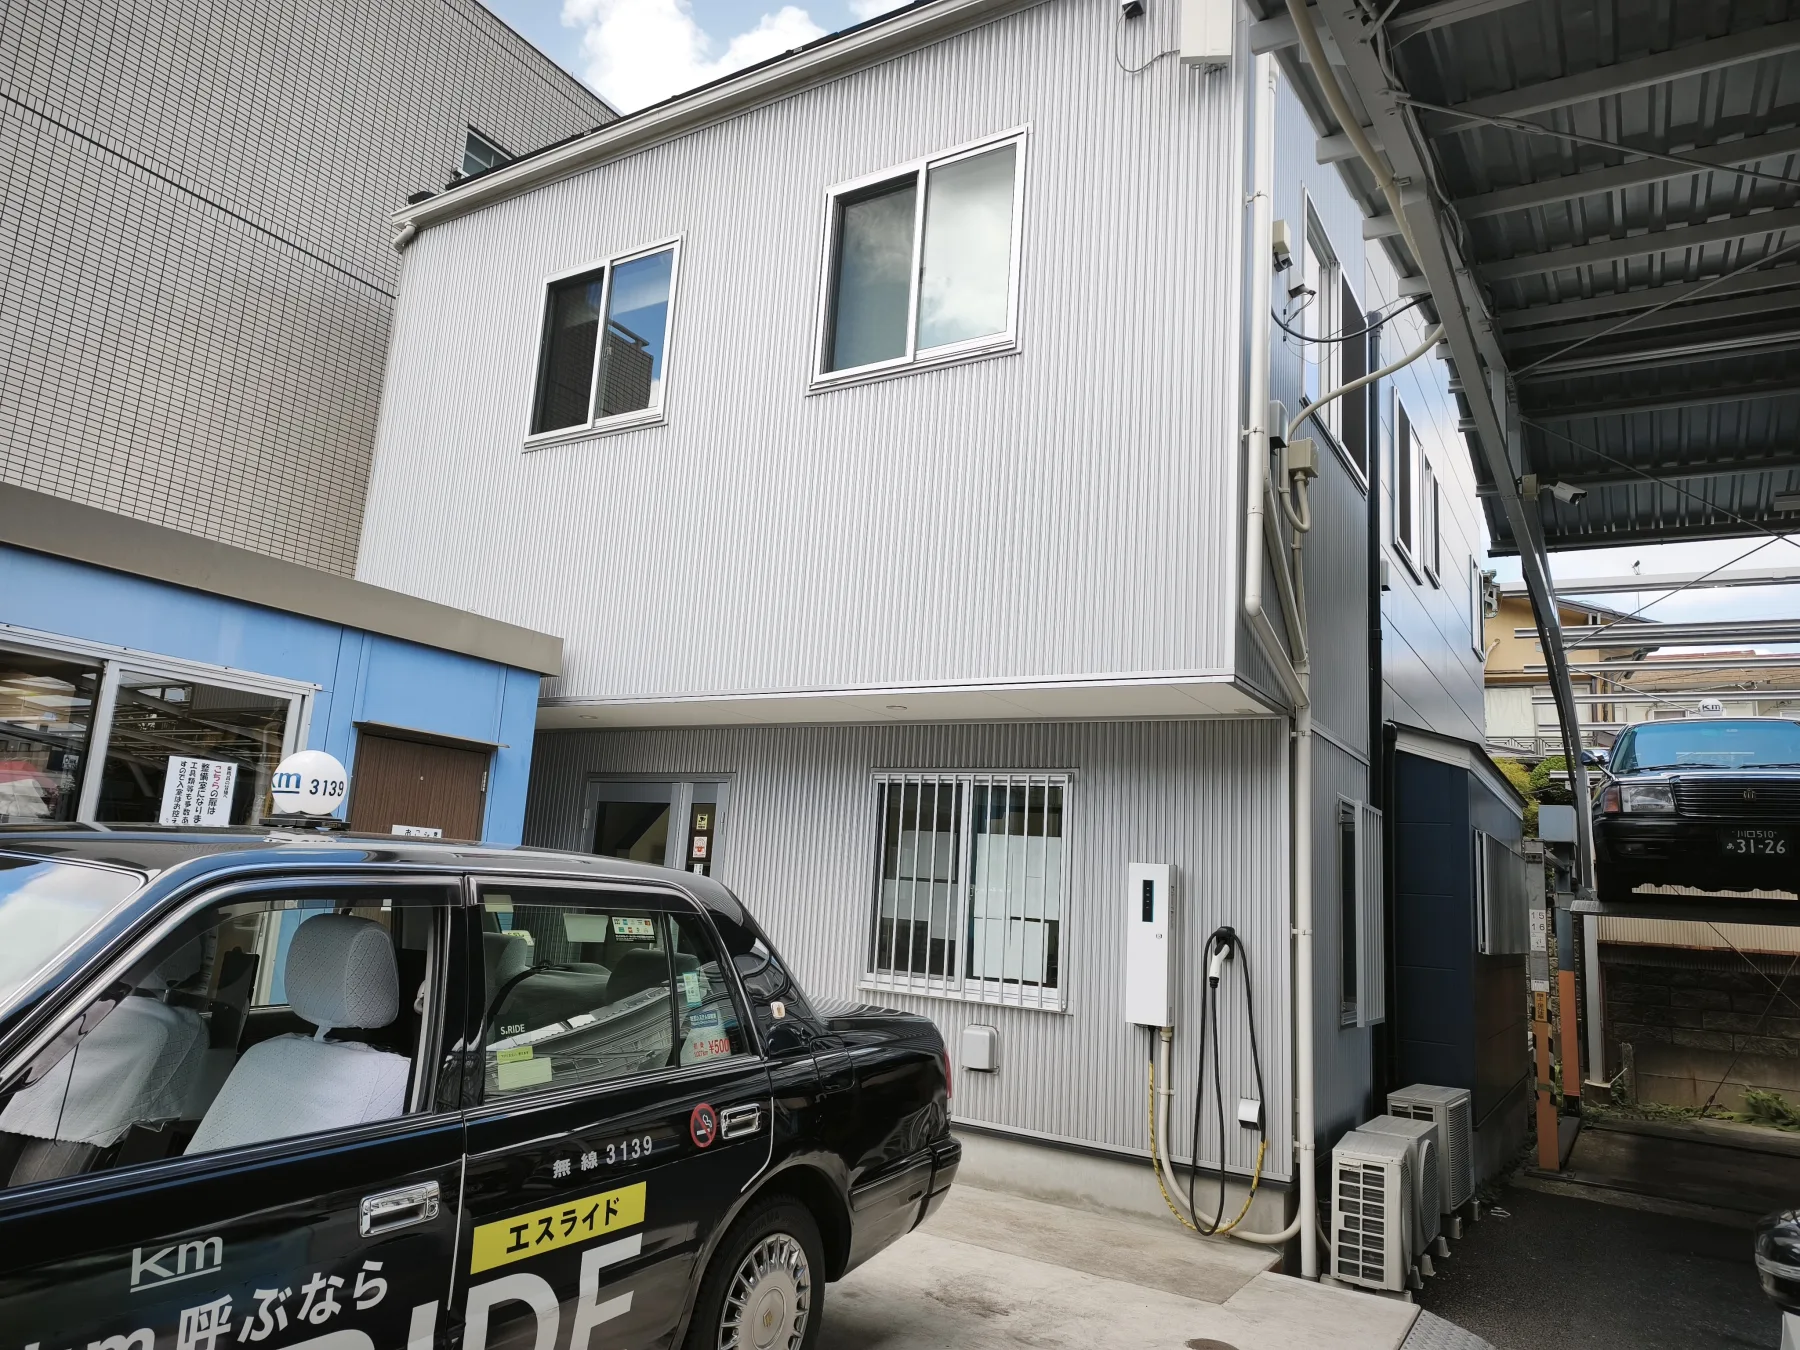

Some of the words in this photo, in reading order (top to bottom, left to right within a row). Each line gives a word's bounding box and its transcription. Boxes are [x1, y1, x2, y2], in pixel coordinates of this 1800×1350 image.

[309, 779, 345, 797] 3139
[1736, 839, 1786, 854] 31-26
[500, 1024, 526, 1035] S.RIDE
[708, 1037, 730, 1055] ¥500
[606, 1135, 653, 1165] 3139
[506, 1197, 620, 1255] エスライド
